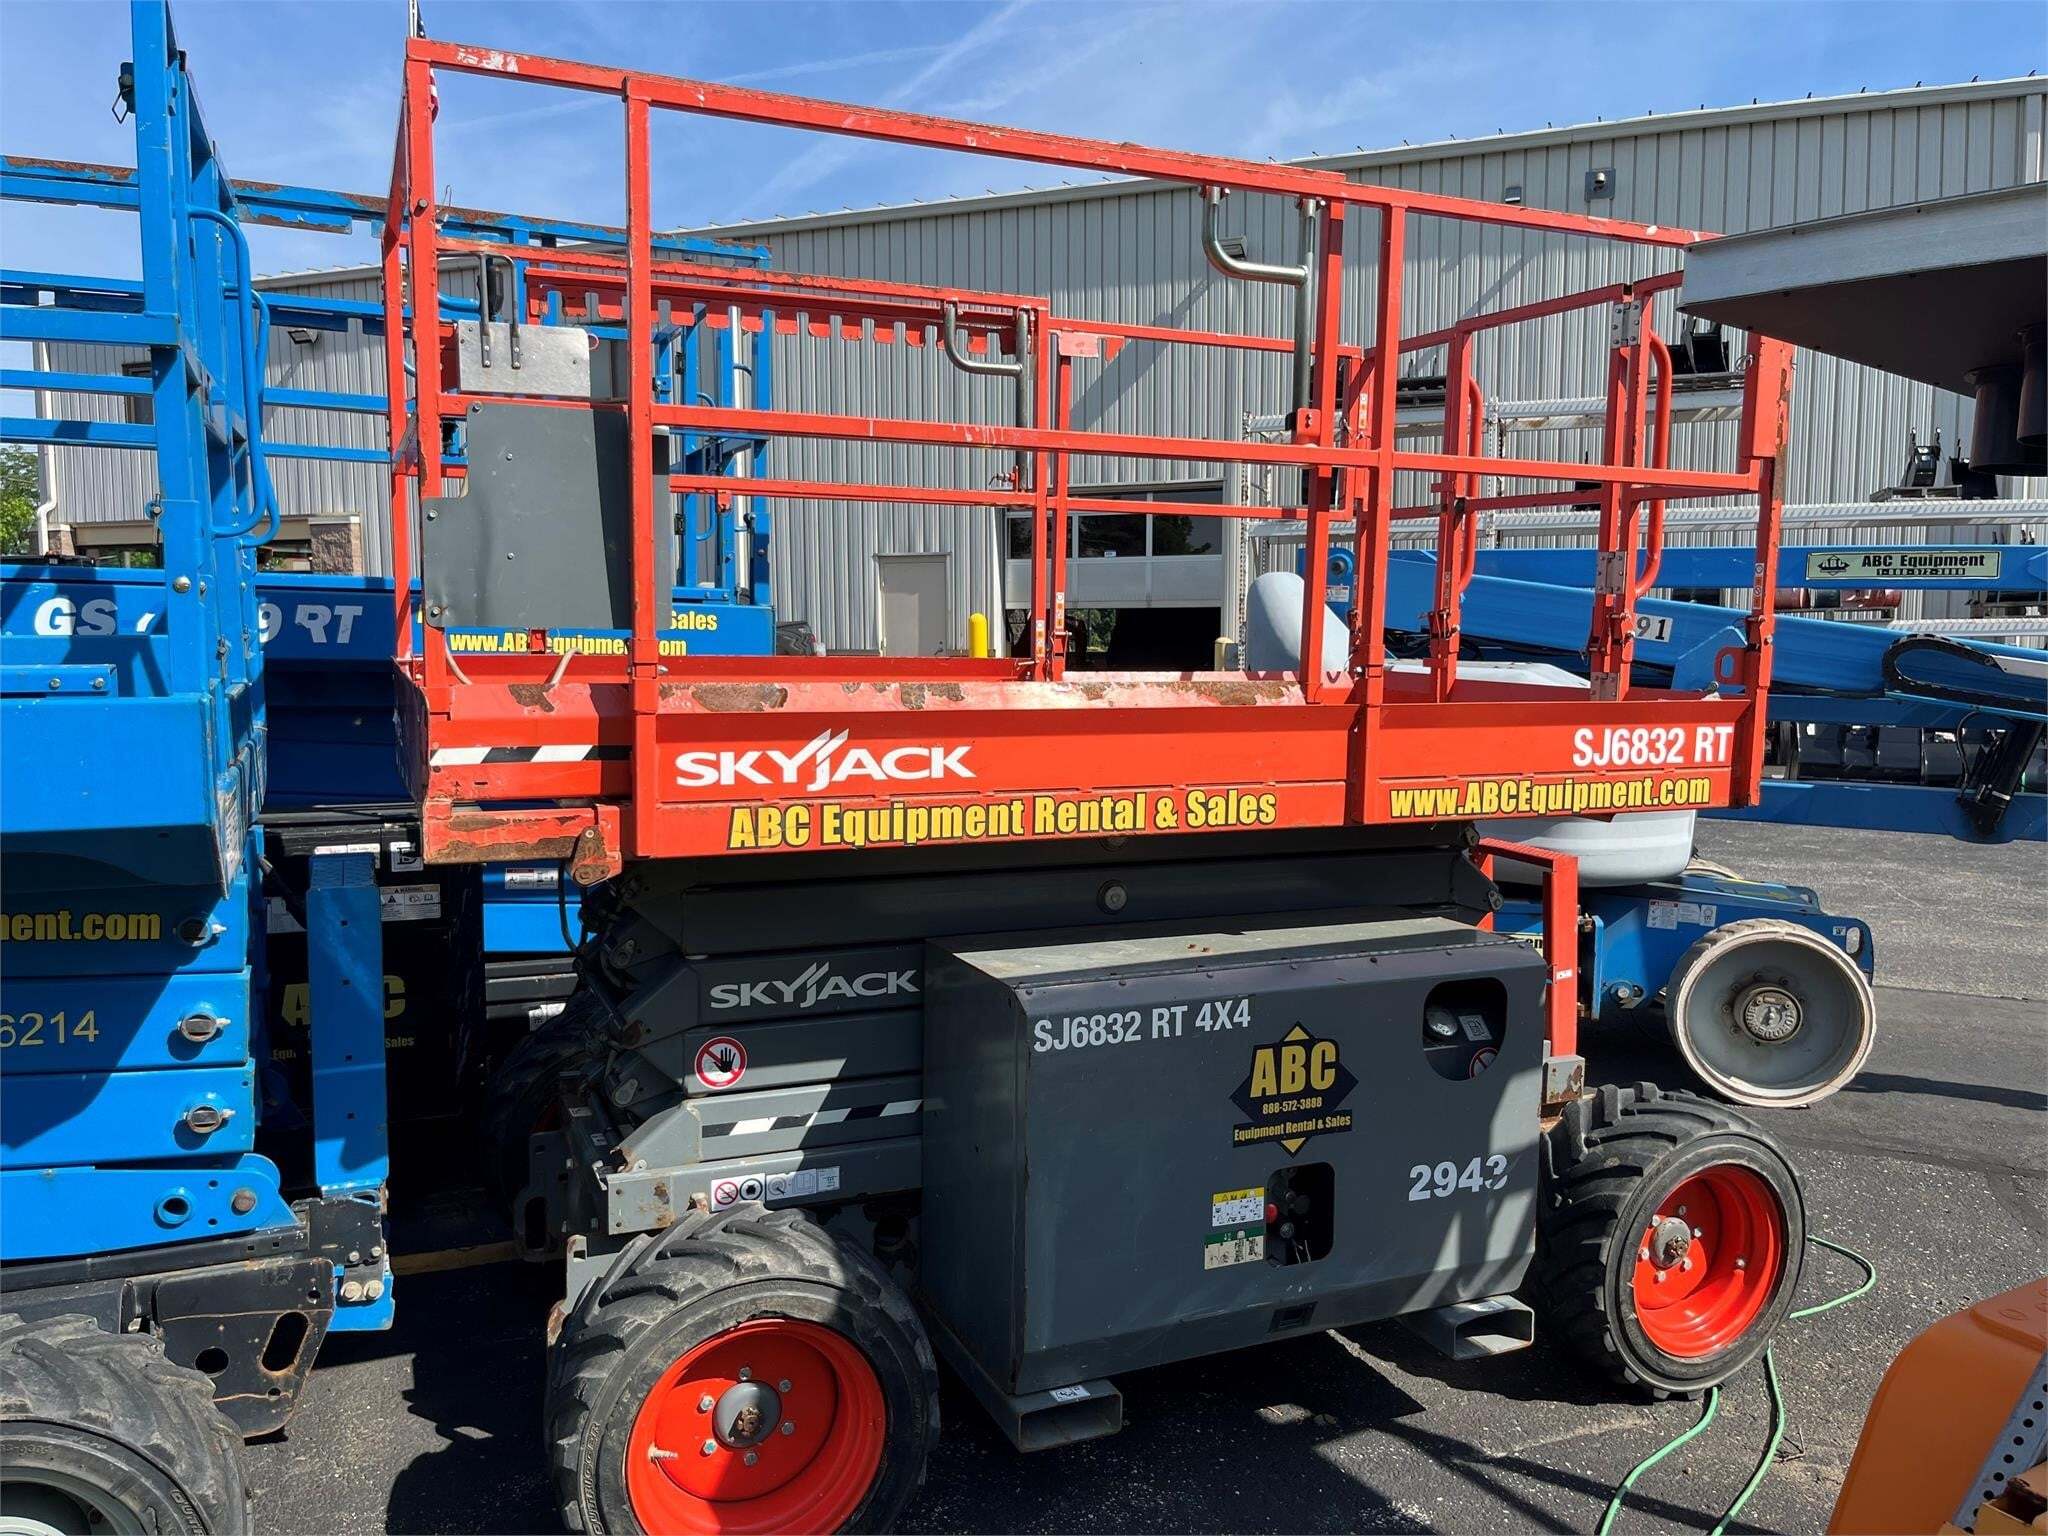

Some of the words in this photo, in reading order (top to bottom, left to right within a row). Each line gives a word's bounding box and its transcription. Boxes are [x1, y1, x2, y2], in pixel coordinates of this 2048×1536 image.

[1862, 554, 1893, 567] ABC
[1900, 554, 1985, 569] Equipment
[295, 604, 363, 644] RT
[675, 728, 977, 792] SKYJACK
[1572, 726, 1685, 767] SJ6832
[1693, 725, 1734, 763] RT
[727, 803, 812, 850] ABC
[820, 796, 1026, 850] Equipment
[1033, 792, 1148, 836] Rental
[1154, 796, 1180, 829] &
[1185, 788, 1278, 828] Sales
[1389, 776, 1712, 819] www.ABCEquipment.com
[0, 910, 161, 941] ent.com
[709, 961, 921, 1010] SKYJACK
[1033, 1010, 1142, 1053] SJ6832
[1151, 1004, 1189, 1040] RT
[1195, 998, 1252, 1033] 4X4
[1250, 1041, 1337, 1099] ABC
[1233, 1123, 1285, 1143] Equipment
[1285, 1118, 1316, 1135] Rental
[1325, 1115, 1352, 1129] Sales
[1408, 1154, 1508, 1201] 2943
